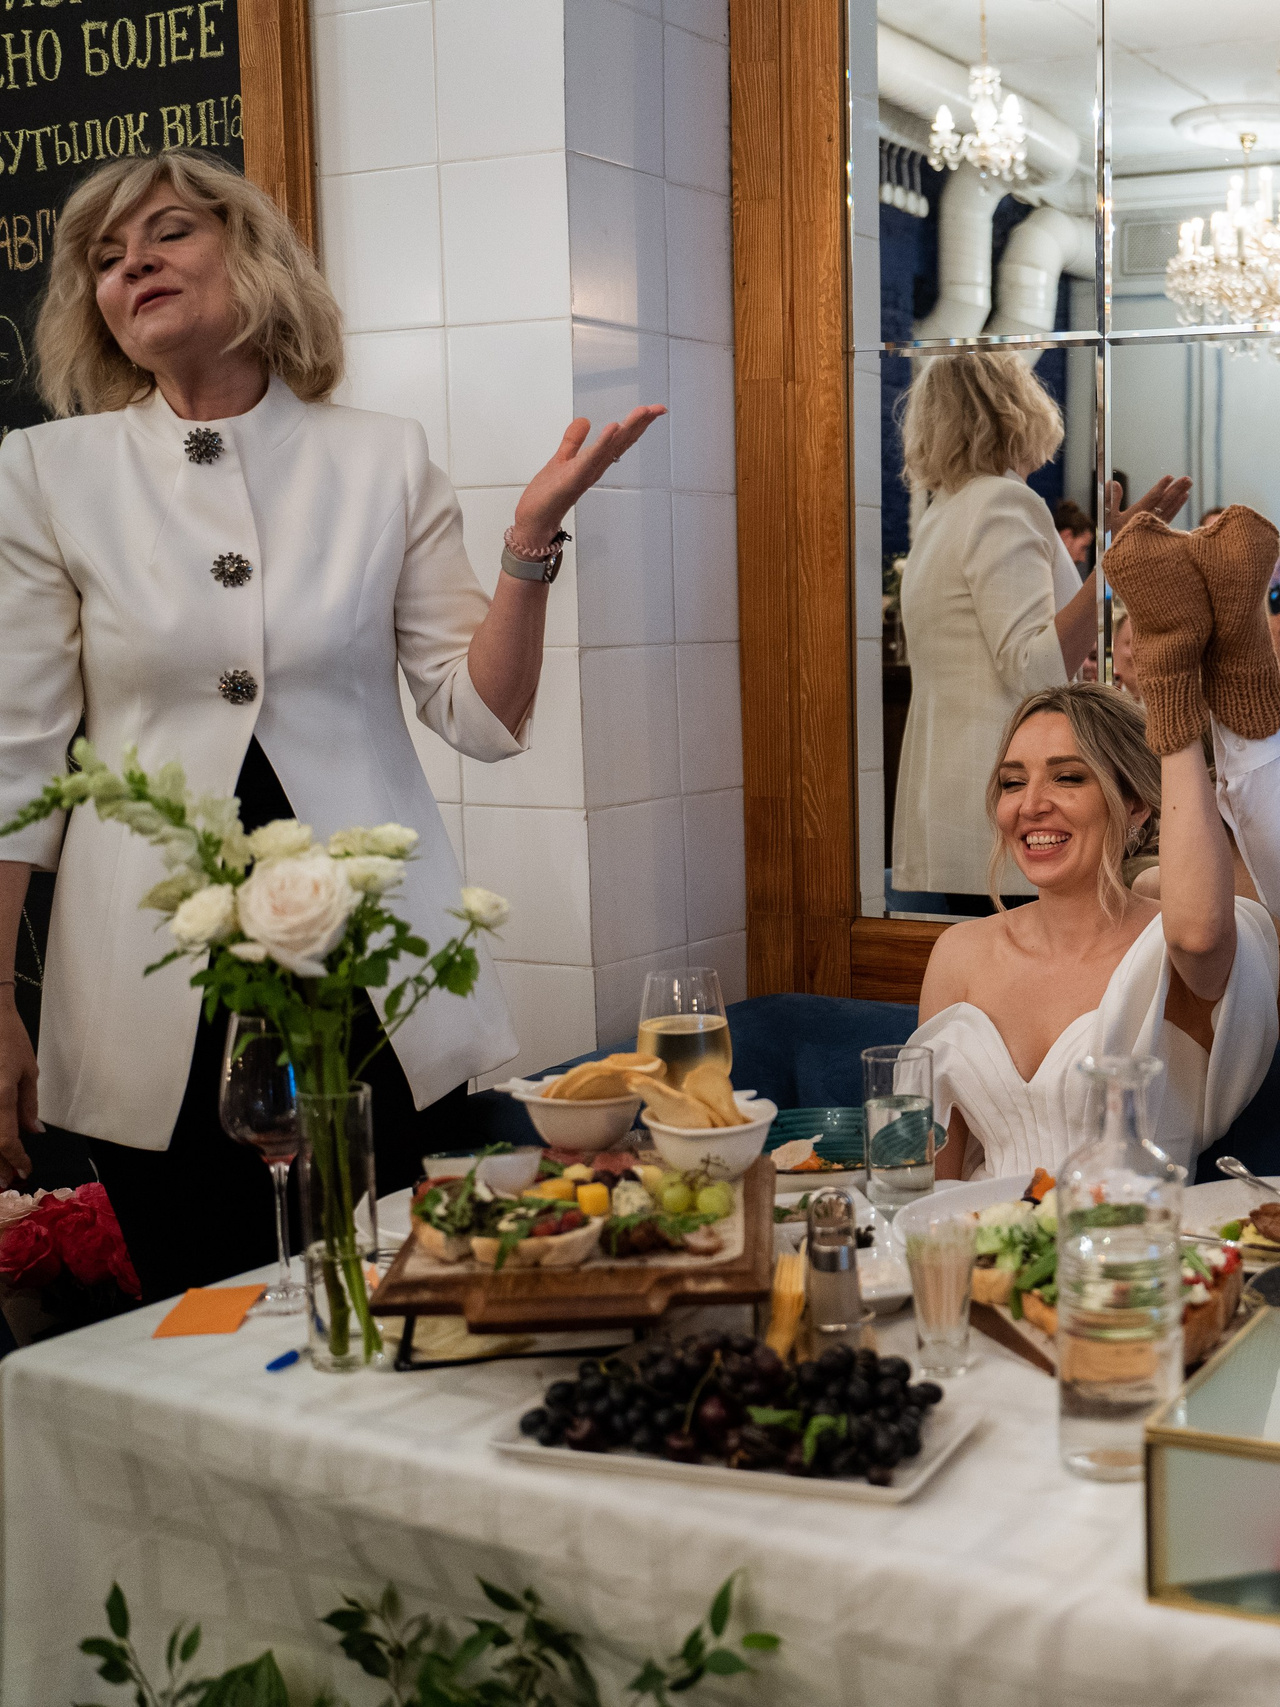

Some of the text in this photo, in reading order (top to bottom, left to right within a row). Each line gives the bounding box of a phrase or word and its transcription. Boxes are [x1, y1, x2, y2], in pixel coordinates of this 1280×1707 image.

[0, 0, 224, 89] НО БОЛЕЕ
[0, 112, 149, 175] УТЫЛОК
